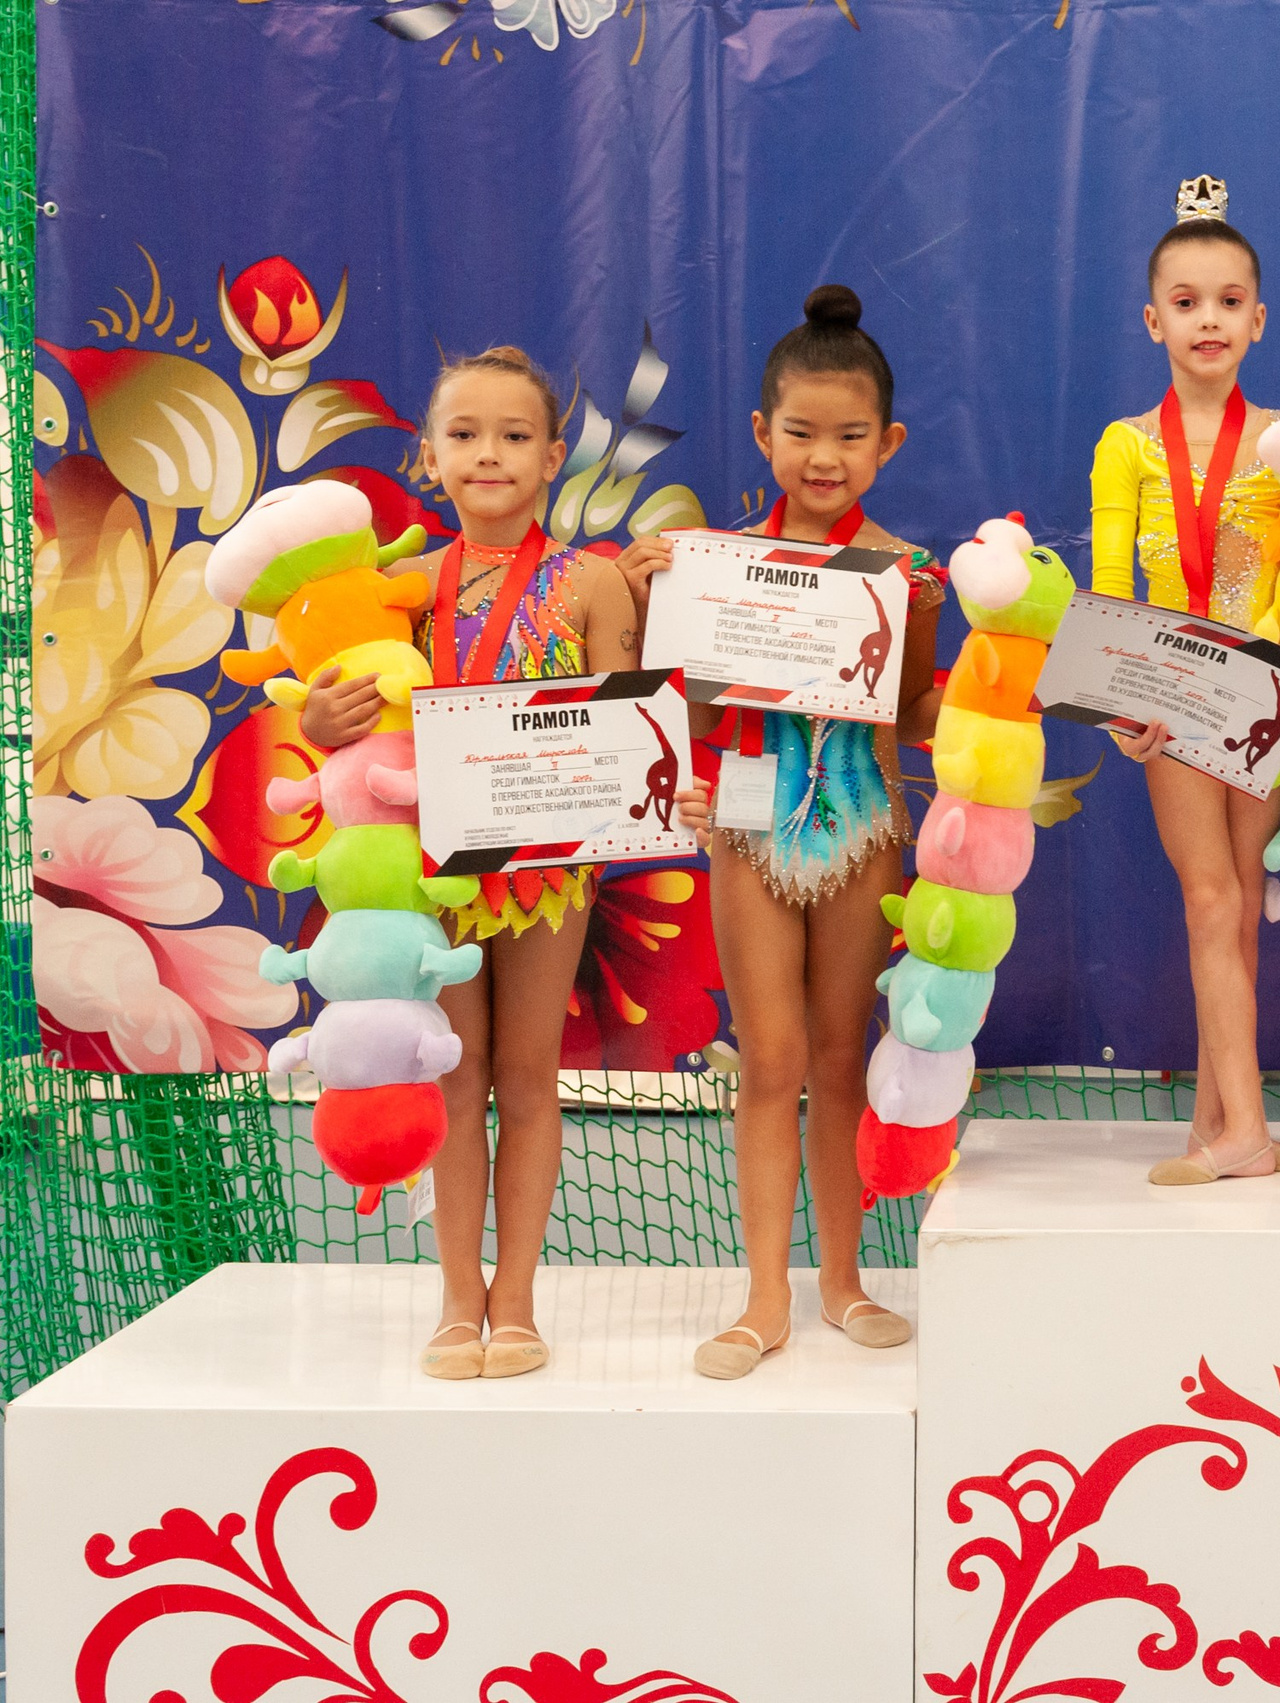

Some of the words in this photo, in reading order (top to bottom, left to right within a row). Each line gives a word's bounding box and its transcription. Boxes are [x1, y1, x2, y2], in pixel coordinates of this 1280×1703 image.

[746, 565, 818, 589] ГРАМОТА
[762, 589, 799, 598] НАГРАЖДАЕТСЯ
[717, 619, 739, 629] СРЕДИ
[740, 621, 781, 634] ГИМНАСТОК
[718, 606, 757, 618] ЗАНЯВШАЯ
[815, 619, 838, 628] МЕСТО
[714, 631, 720, 639] В
[720, 632, 763, 644] ПЕРВЕНСТВЕ
[765, 637, 808, 650] АКСАЙСКОГО
[810, 643, 836, 653] РАЙОНА
[1154, 632, 1228, 665] ГРАМОТА
[713, 644, 723, 652] ПО
[724, 645, 789, 661] ХУДОЖЕСТВЕННОЙ
[790, 653, 835, 666] ГИМНАСТИКЕ
[1168, 652, 1205, 666] НАГРАЖДАЕТСЯ
[1115, 667, 1138, 677] СРЕДИ
[1138, 672, 1179, 689] ГИМНАСТОК
[1119, 658, 1158, 673] ЗАНЯВШАЯ
[1214, 688, 1236, 702] МЕСТО
[1107, 685, 1118, 693] ПО
[1118, 687, 1181, 712] ХУДОЖЕСТВЕННОЙ
[1181, 708, 1223, 733] ГИМНАСТИКЕ
[1116, 678, 1158, 693] ПЕРВЕНСТВЕ
[1159, 690, 1201, 710] АКСАЙСКОГО
[1202, 706, 1228, 723] РАЙОНА
[512, 708, 591, 731] ГРАМОТА
[533, 734, 572, 742] НАГРАЖДАЕТСЯ
[491, 762, 531, 774] ЗАНЯВШАЯ
[594, 755, 619, 766] МЕСТО
[491, 778, 515, 788] СРЕДИ
[517, 774, 560, 786] ГИМНАСТОК
[492, 792, 497, 802] В
[498, 789, 543, 801] ПЕРВЕНСТВЕ
[545, 785, 591, 797] АКСАЙСКОГО
[593, 783, 622, 795] РАЙОНА
[493, 806, 503, 816] ПО
[504, 800, 573, 816] ХУДОЖЕСТВЕННОЙ
[575, 797, 622, 810] ГИМНАСТИКЕ
